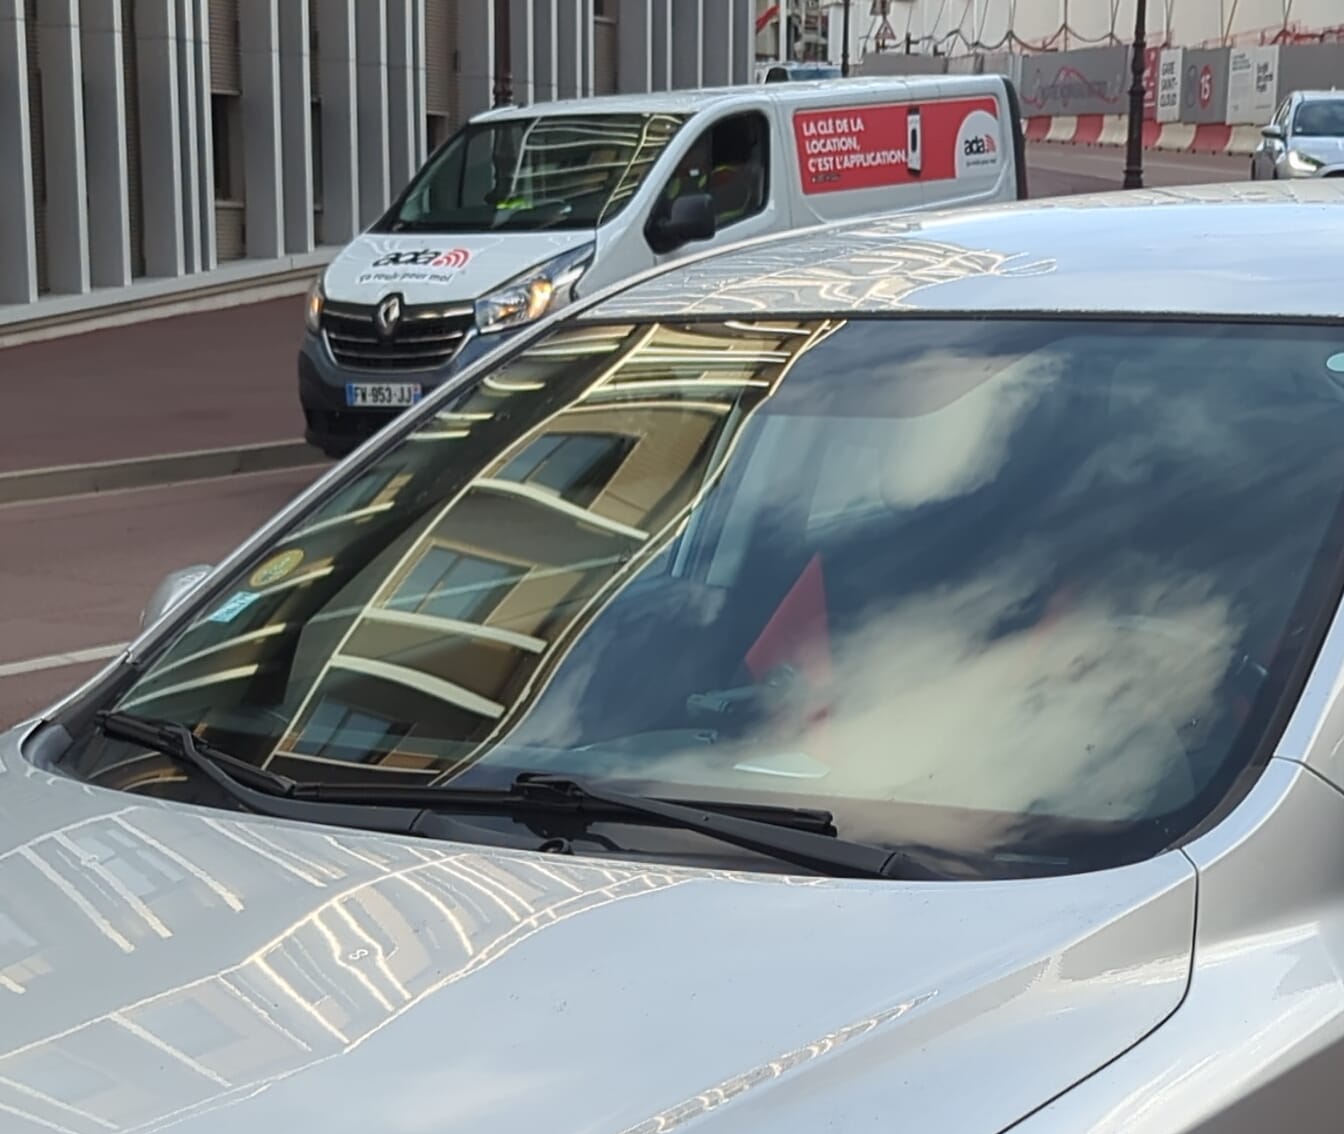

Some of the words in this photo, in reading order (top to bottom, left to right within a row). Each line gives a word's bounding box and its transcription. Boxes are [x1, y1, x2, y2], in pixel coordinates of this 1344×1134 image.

[803, 121, 817, 136] LA
[836, 120, 848, 133] DE
[850, 117, 864, 132] LA
[964, 136, 985, 156] ada
[372, 249, 441, 268] ada
